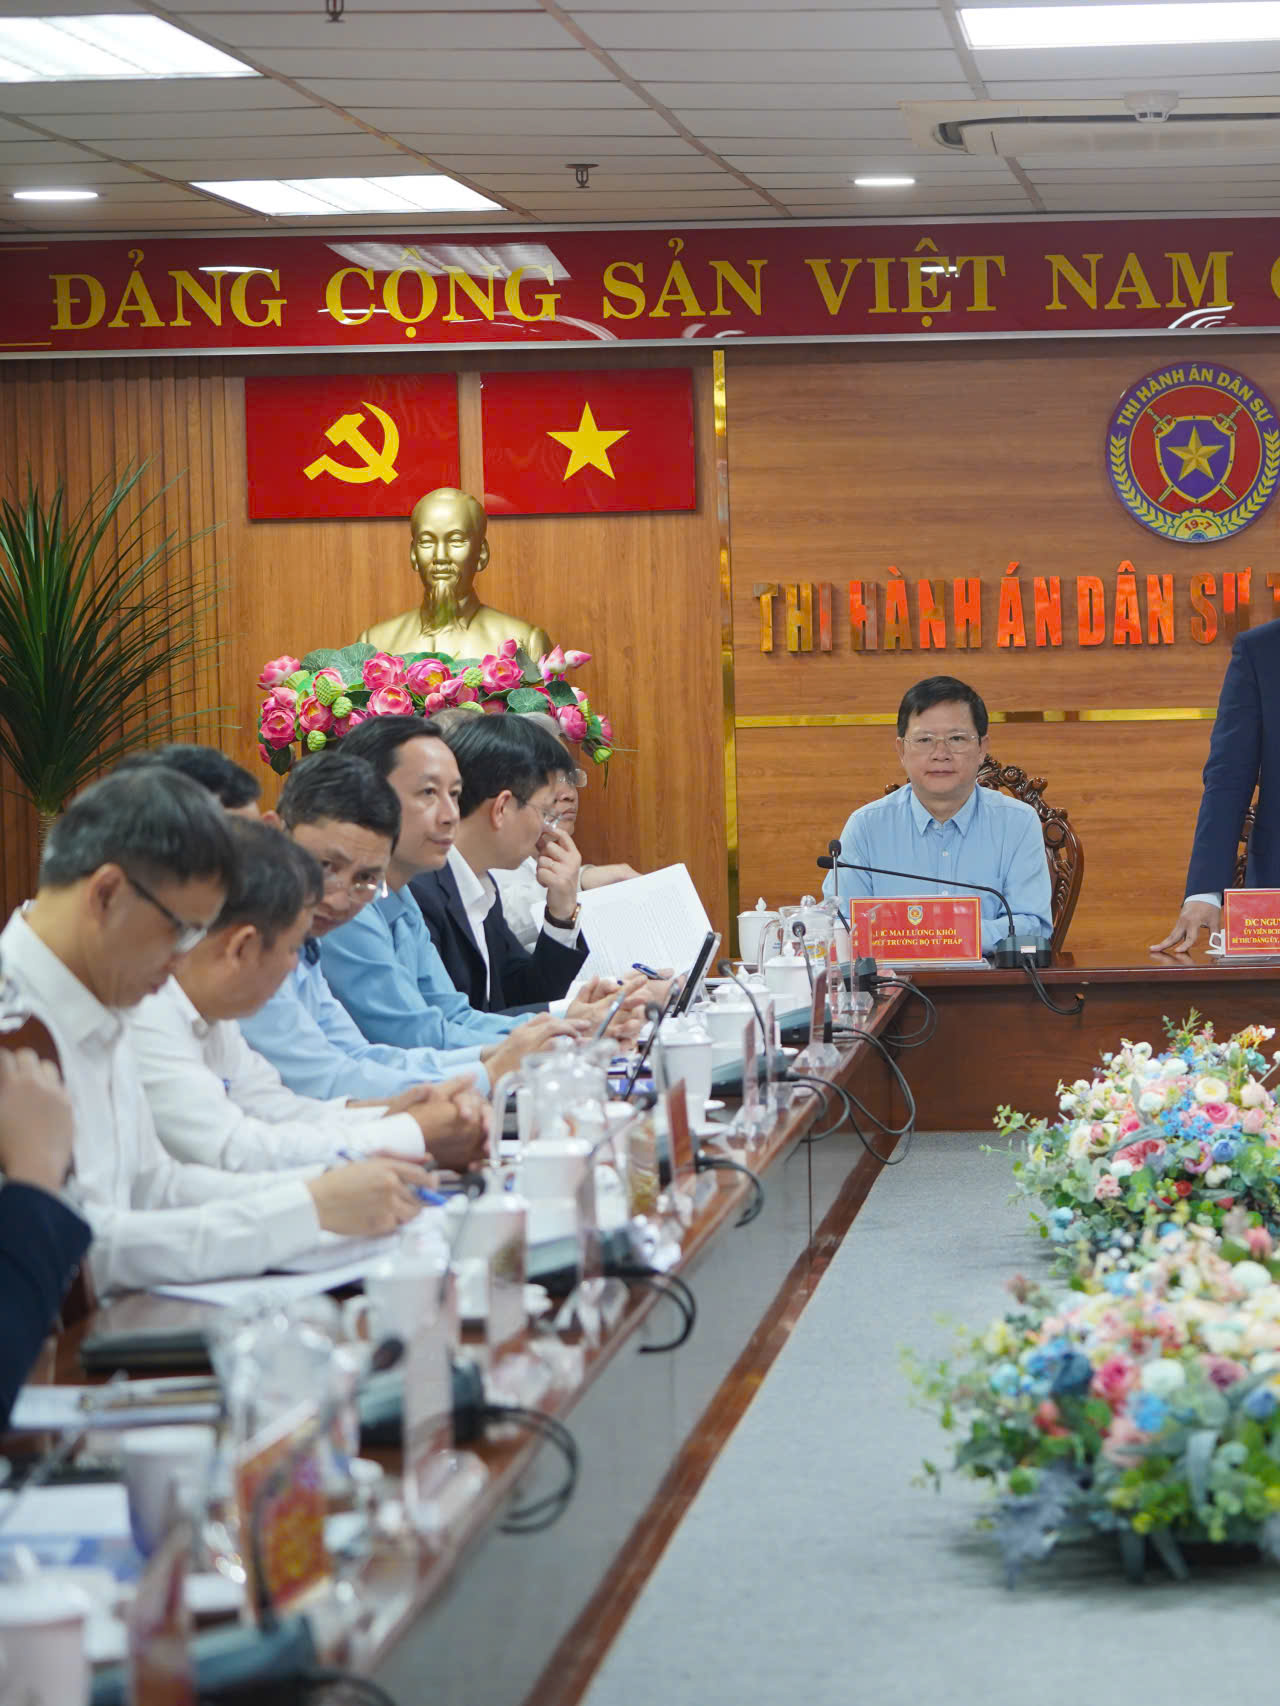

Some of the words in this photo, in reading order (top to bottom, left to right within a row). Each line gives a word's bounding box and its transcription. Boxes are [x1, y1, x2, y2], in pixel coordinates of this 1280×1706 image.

[50, 249, 287, 330] ĐẢNG
[326, 247, 561, 338] CỘNG
[602, 237, 768, 320] SẢN
[804, 237, 1005, 327] VIỆT
[1045, 251, 1234, 310] NAM
[1117, 398, 1140, 427] THI
[1136, 369, 1184, 404] HÀNH
[1189, 364, 1214, 383] ÁN
[1217, 371, 1253, 401] DÂN
[753, 582, 833, 653] THI
[849, 566, 982, 651] HÀNH
[996, 561, 1062, 647] ÁN
[1077, 560, 1175, 646] DÂN
